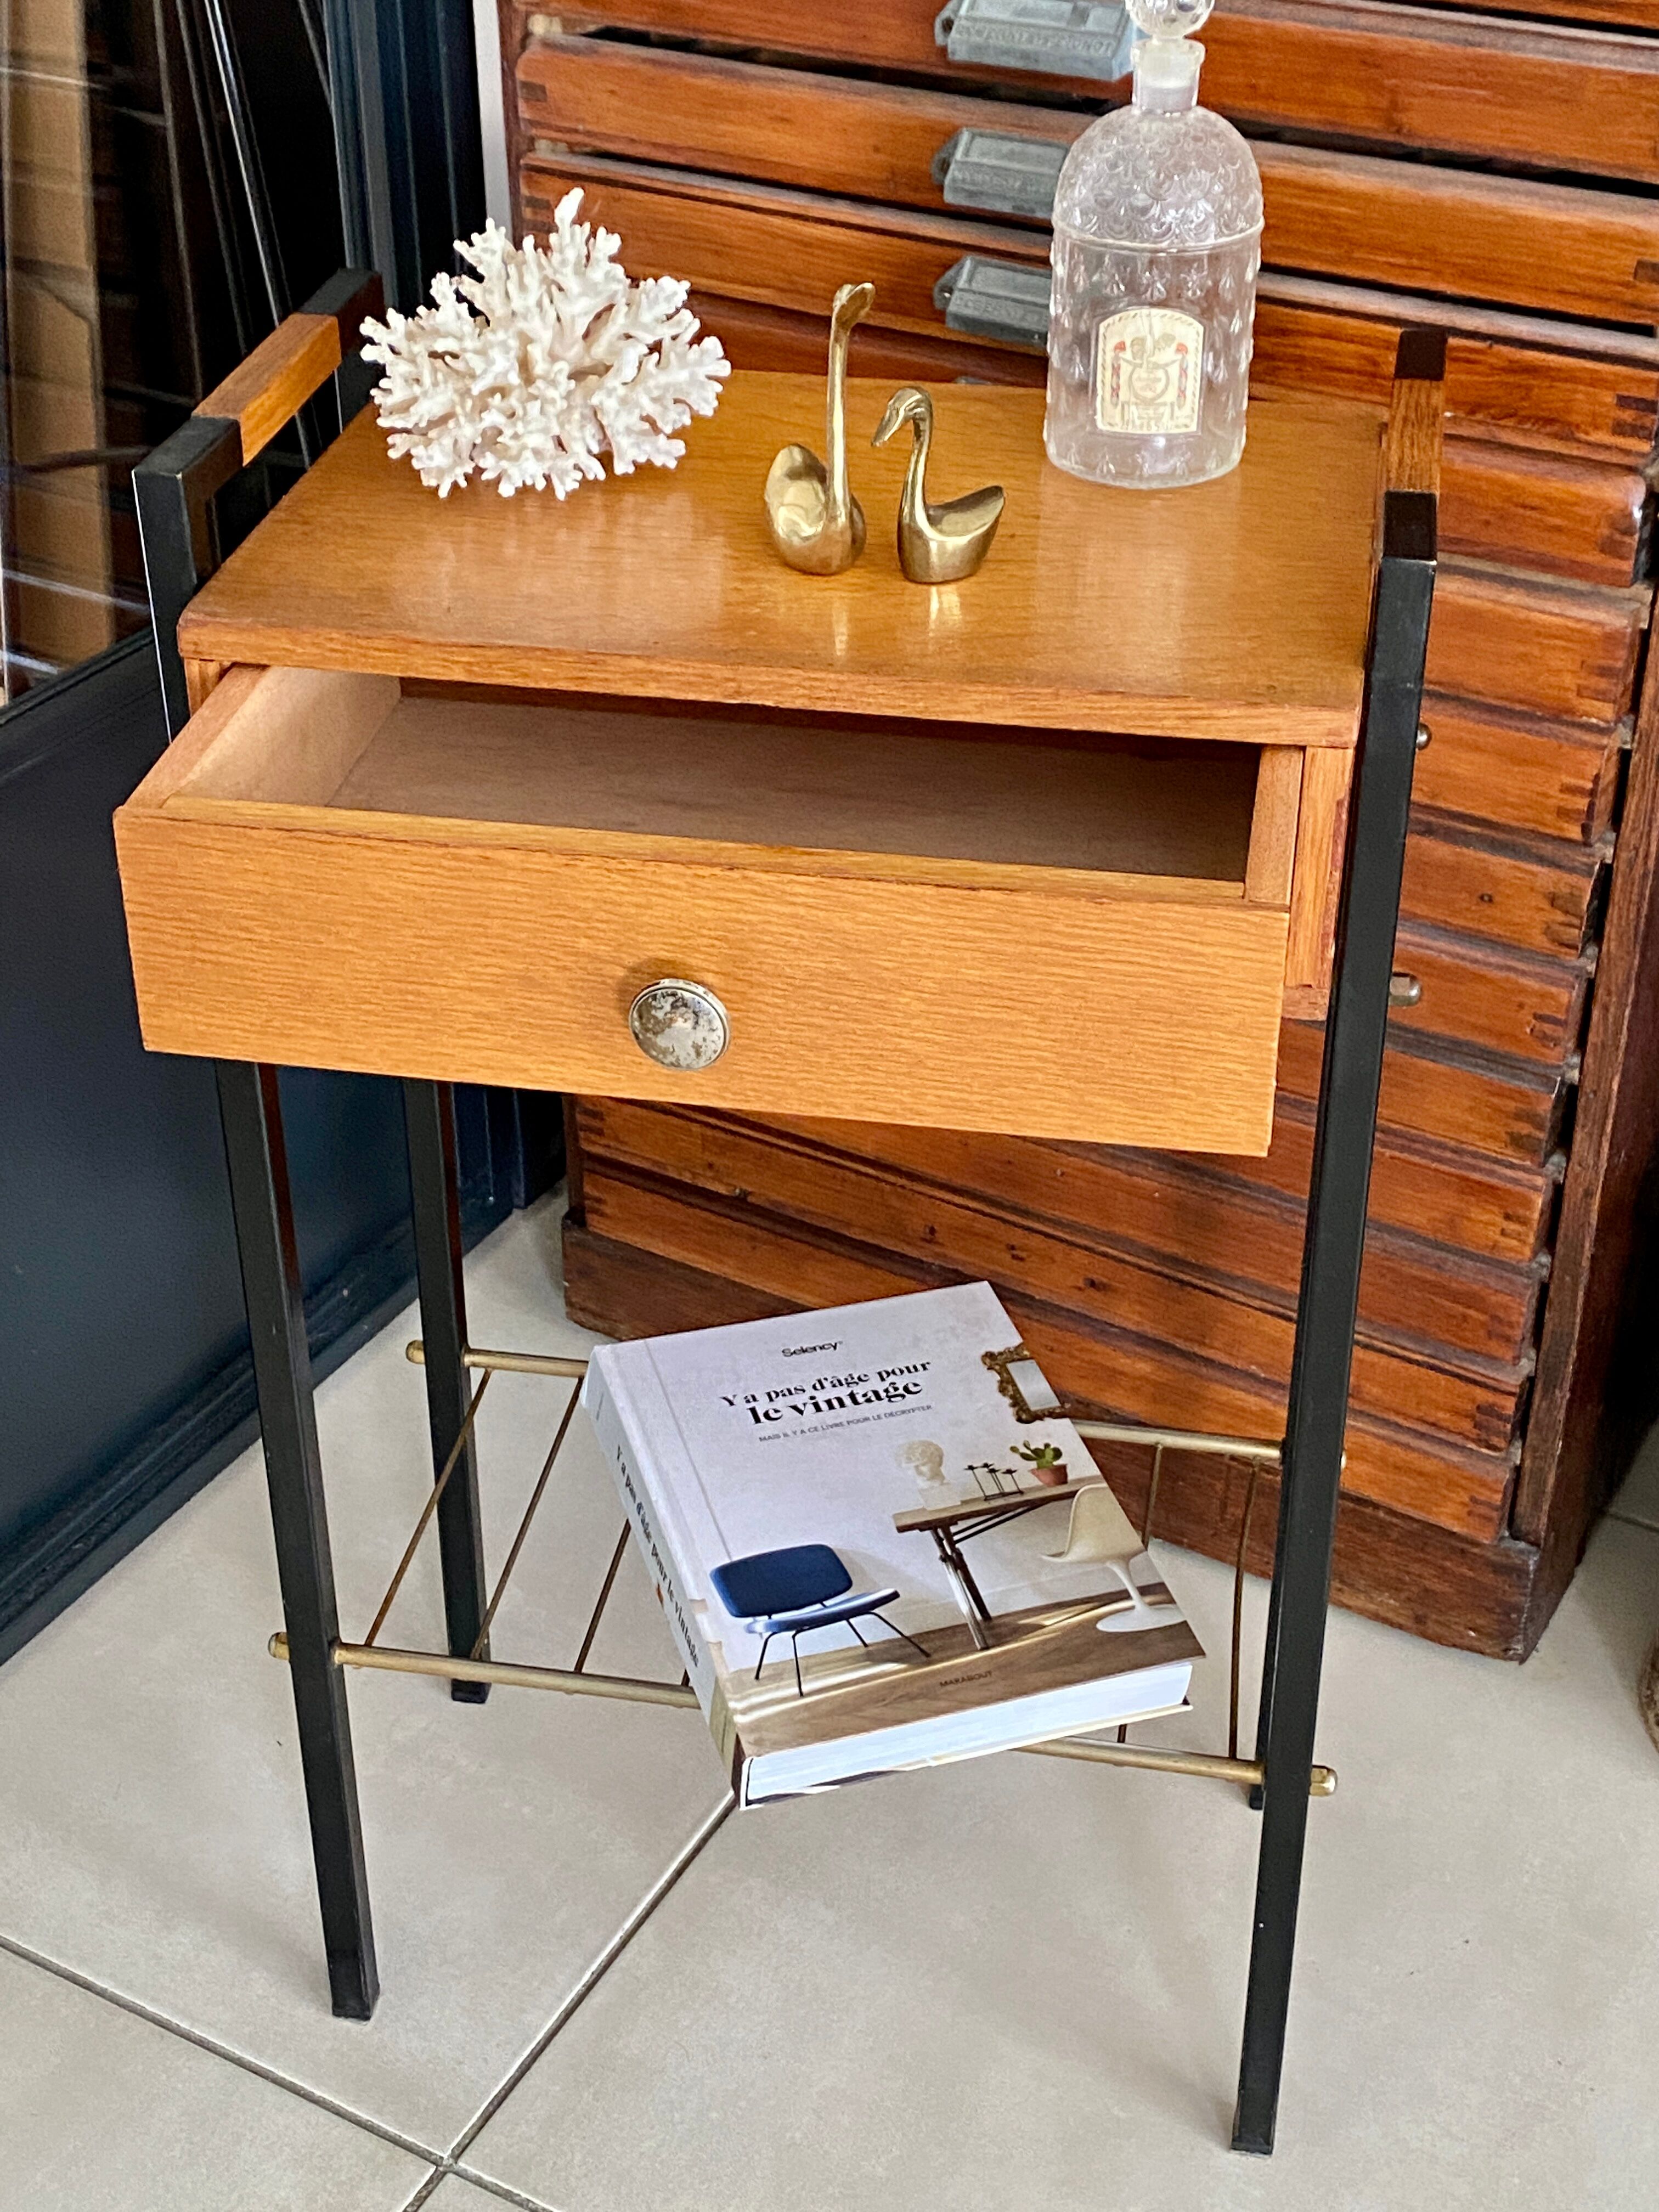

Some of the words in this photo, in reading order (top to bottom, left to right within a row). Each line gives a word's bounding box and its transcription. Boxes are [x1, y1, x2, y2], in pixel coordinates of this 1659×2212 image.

[782, 1342, 837, 1357] Selency
[720, 1395, 737, 1407] Y
[744, 1394, 759, 1405] a
[765, 1385, 806, 1402] pas
[811, 1373, 870, 1391] d'âge
[876, 1361, 932, 1382] pour
[747, 1406, 783, 1424] le
[788, 1381, 923, 1417] vintage
[939, 1670, 992, 1688] MARABOUT
